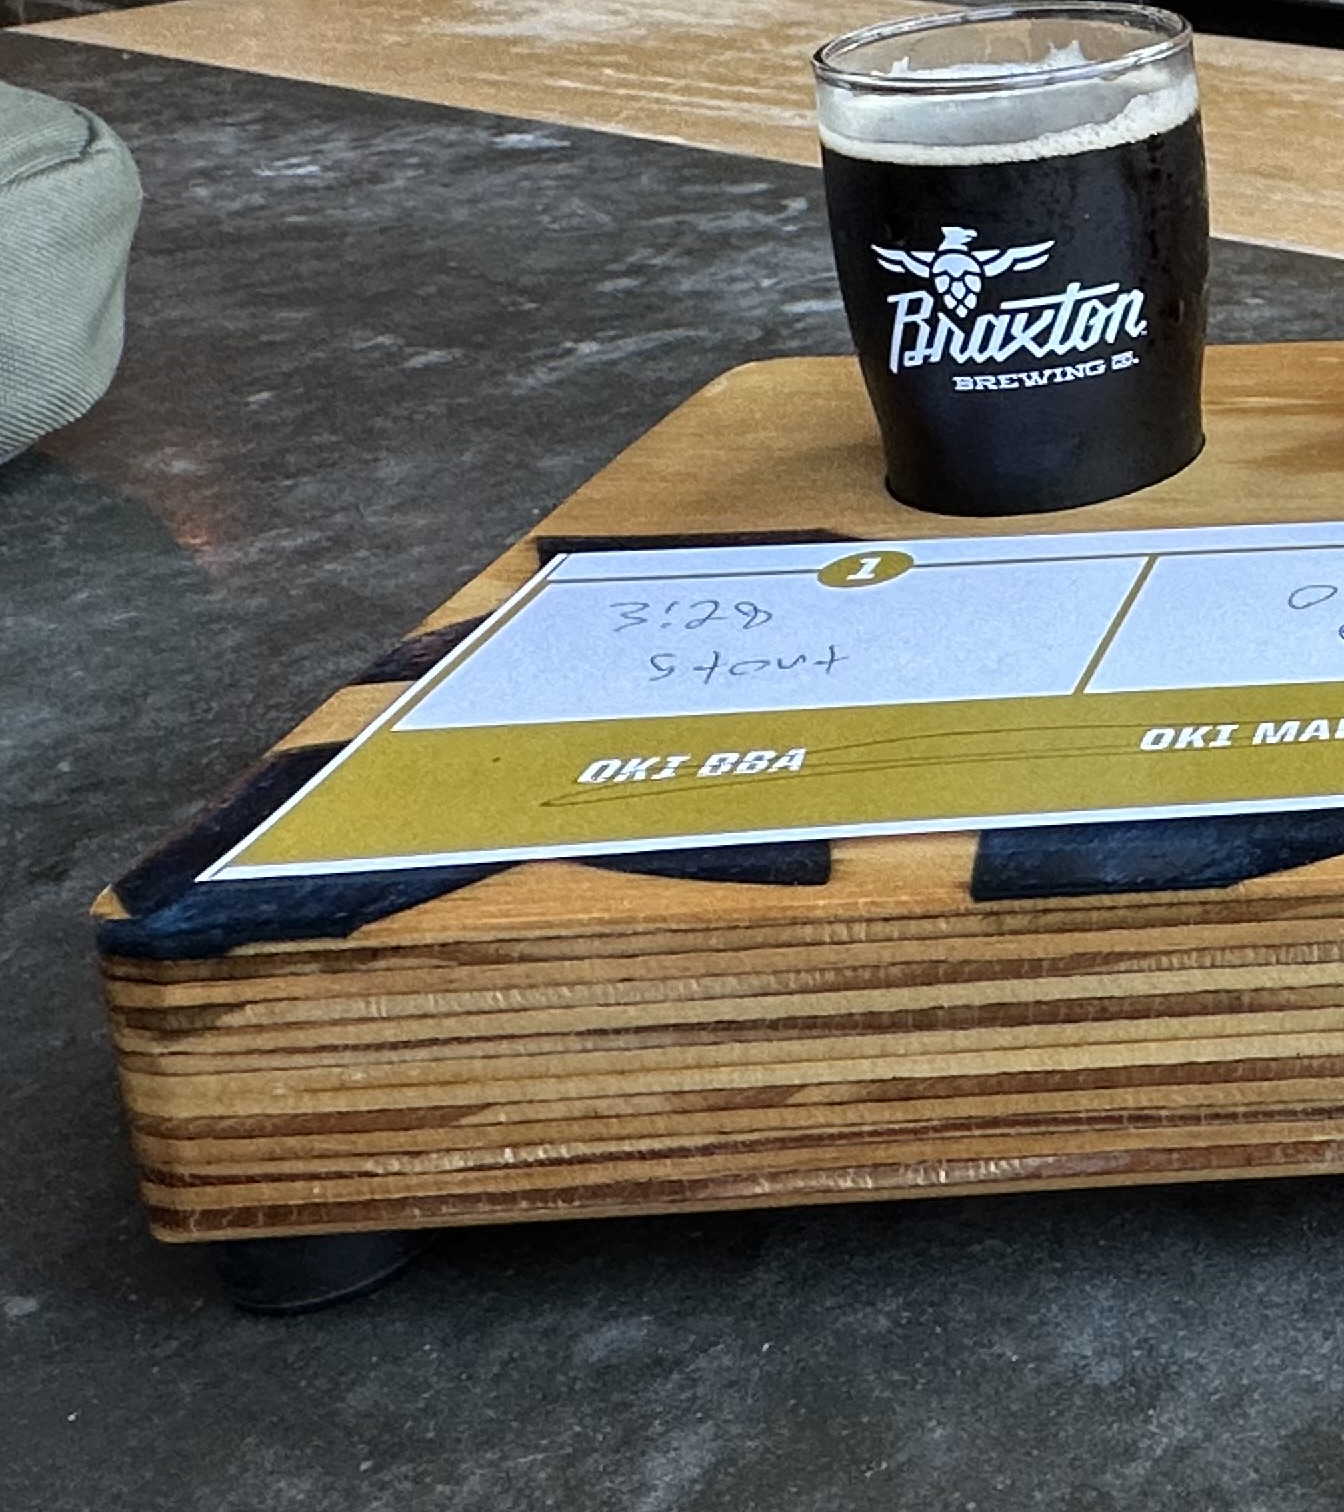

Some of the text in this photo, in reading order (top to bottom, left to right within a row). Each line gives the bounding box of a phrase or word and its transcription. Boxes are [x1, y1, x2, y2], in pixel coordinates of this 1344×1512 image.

[887, 282, 1145, 374] Braxton
[952, 359, 1106, 392] BREWING
[846, 557, 881, 580] 1
[1139, 724, 1240, 752] OKI
[577, 753, 690, 783] OKI
